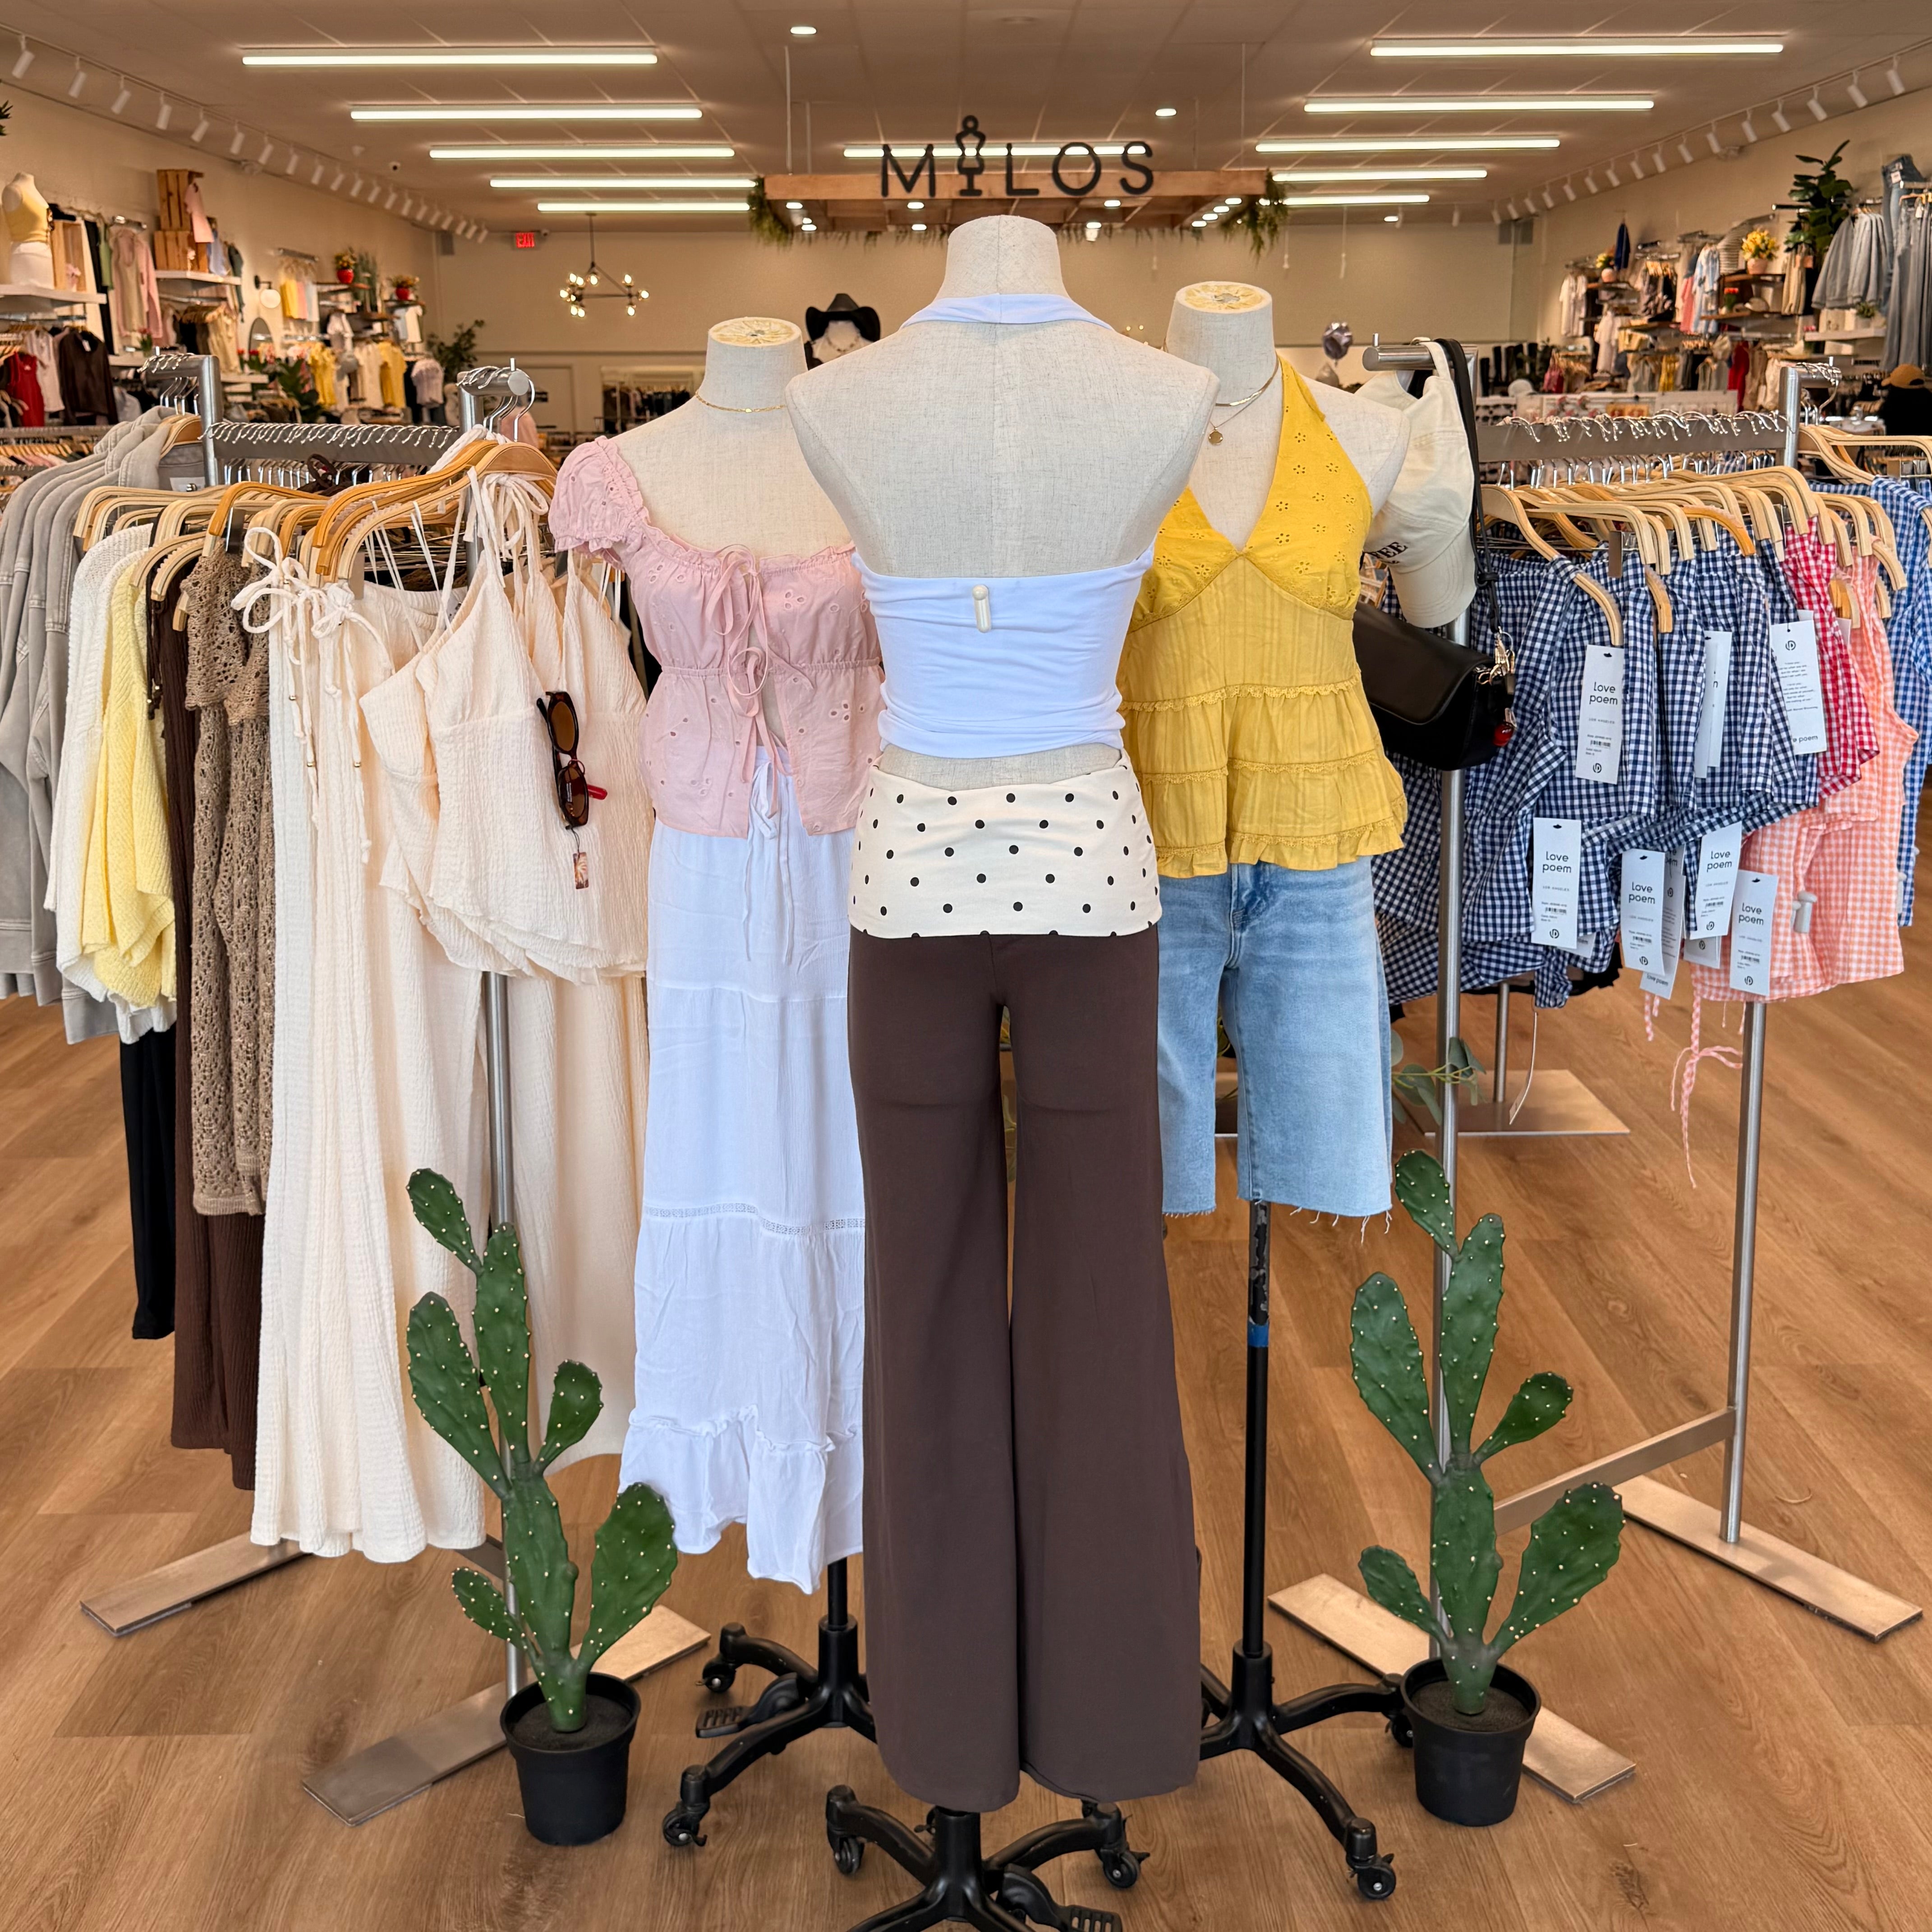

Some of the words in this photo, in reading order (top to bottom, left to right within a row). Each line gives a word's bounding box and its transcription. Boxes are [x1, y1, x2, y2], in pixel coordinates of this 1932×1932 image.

[881, 115, 1154, 198] MILOS
[1589, 695, 1618, 705] poem
[1542, 864, 1571, 873] poem
[1707, 861, 1732, 873] poem
[1628, 894, 1655, 904] poem
[1739, 915, 1764, 925] poem
